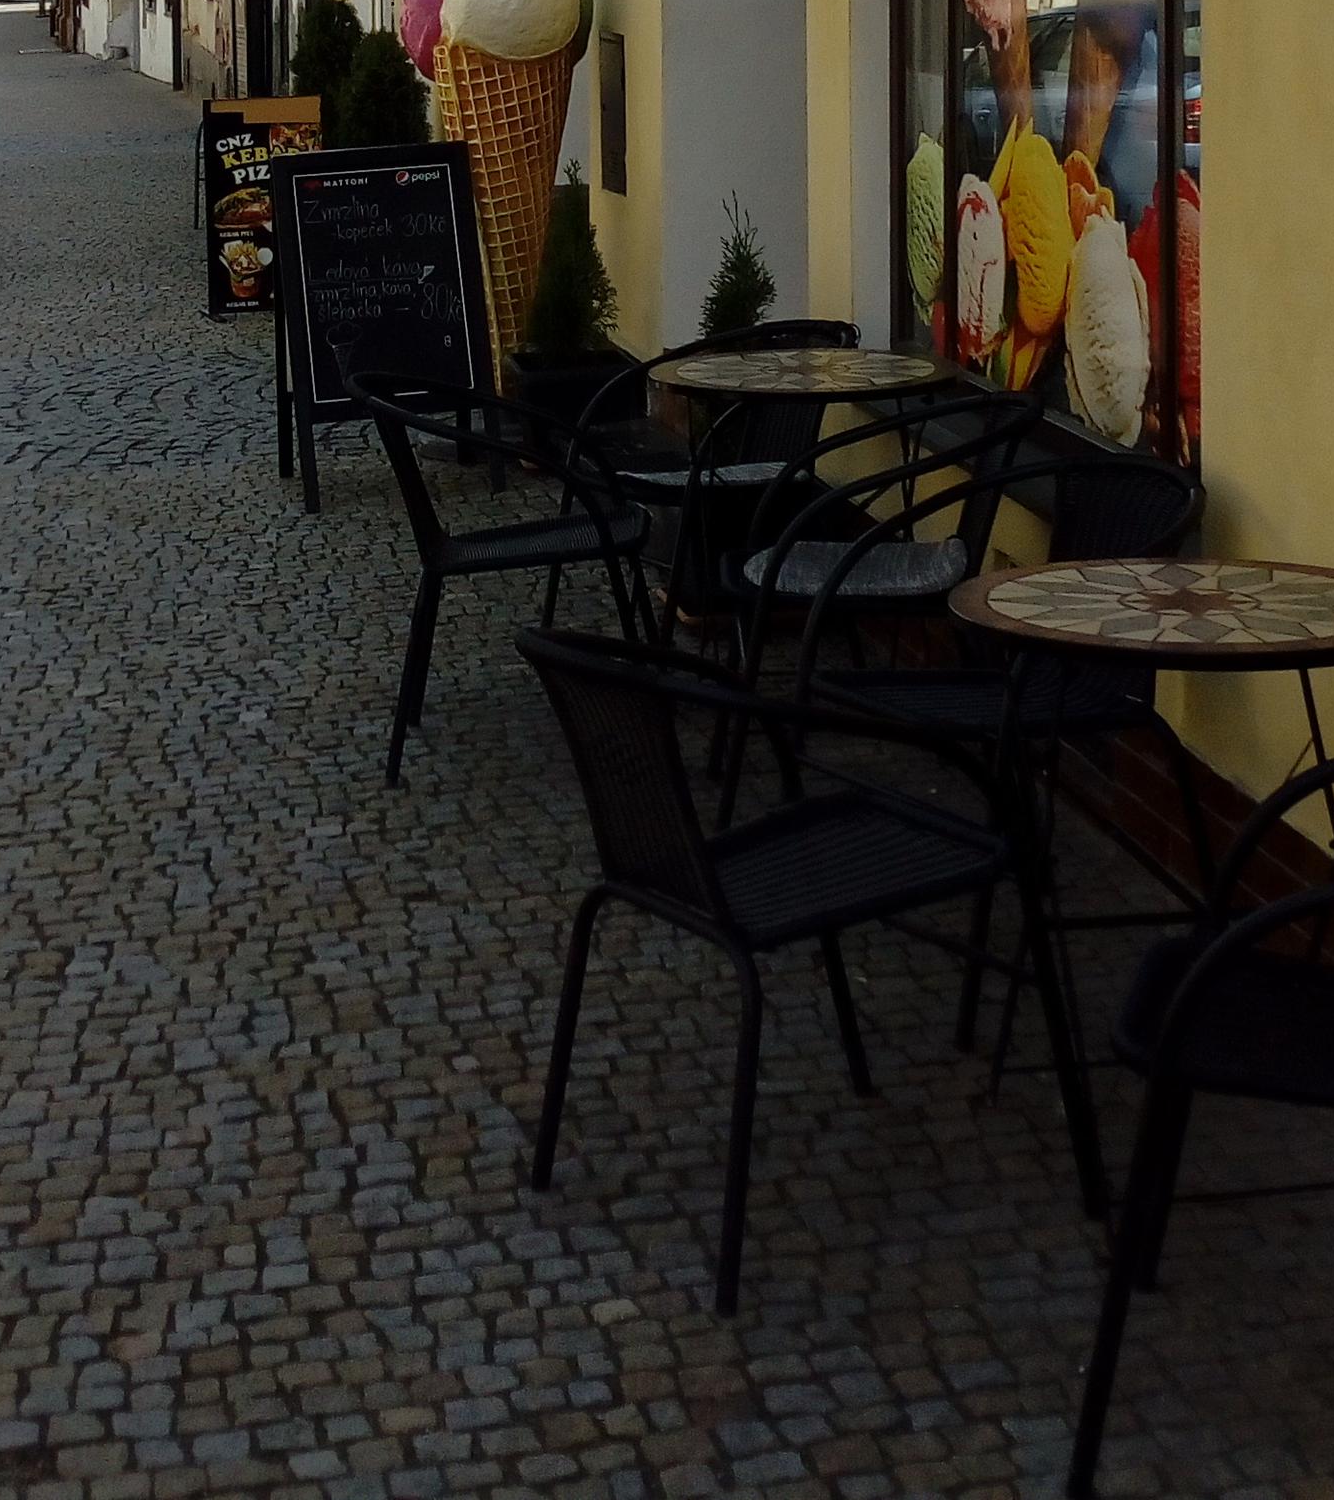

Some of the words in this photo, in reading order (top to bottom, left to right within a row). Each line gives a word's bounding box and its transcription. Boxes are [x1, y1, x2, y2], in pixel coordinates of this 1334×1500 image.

[216, 133, 254, 153] CNZ
[232, 164, 272, 185] PIZ
[323, 177, 368, 188] MATTONI
[411, 171, 441, 183] pepsi
